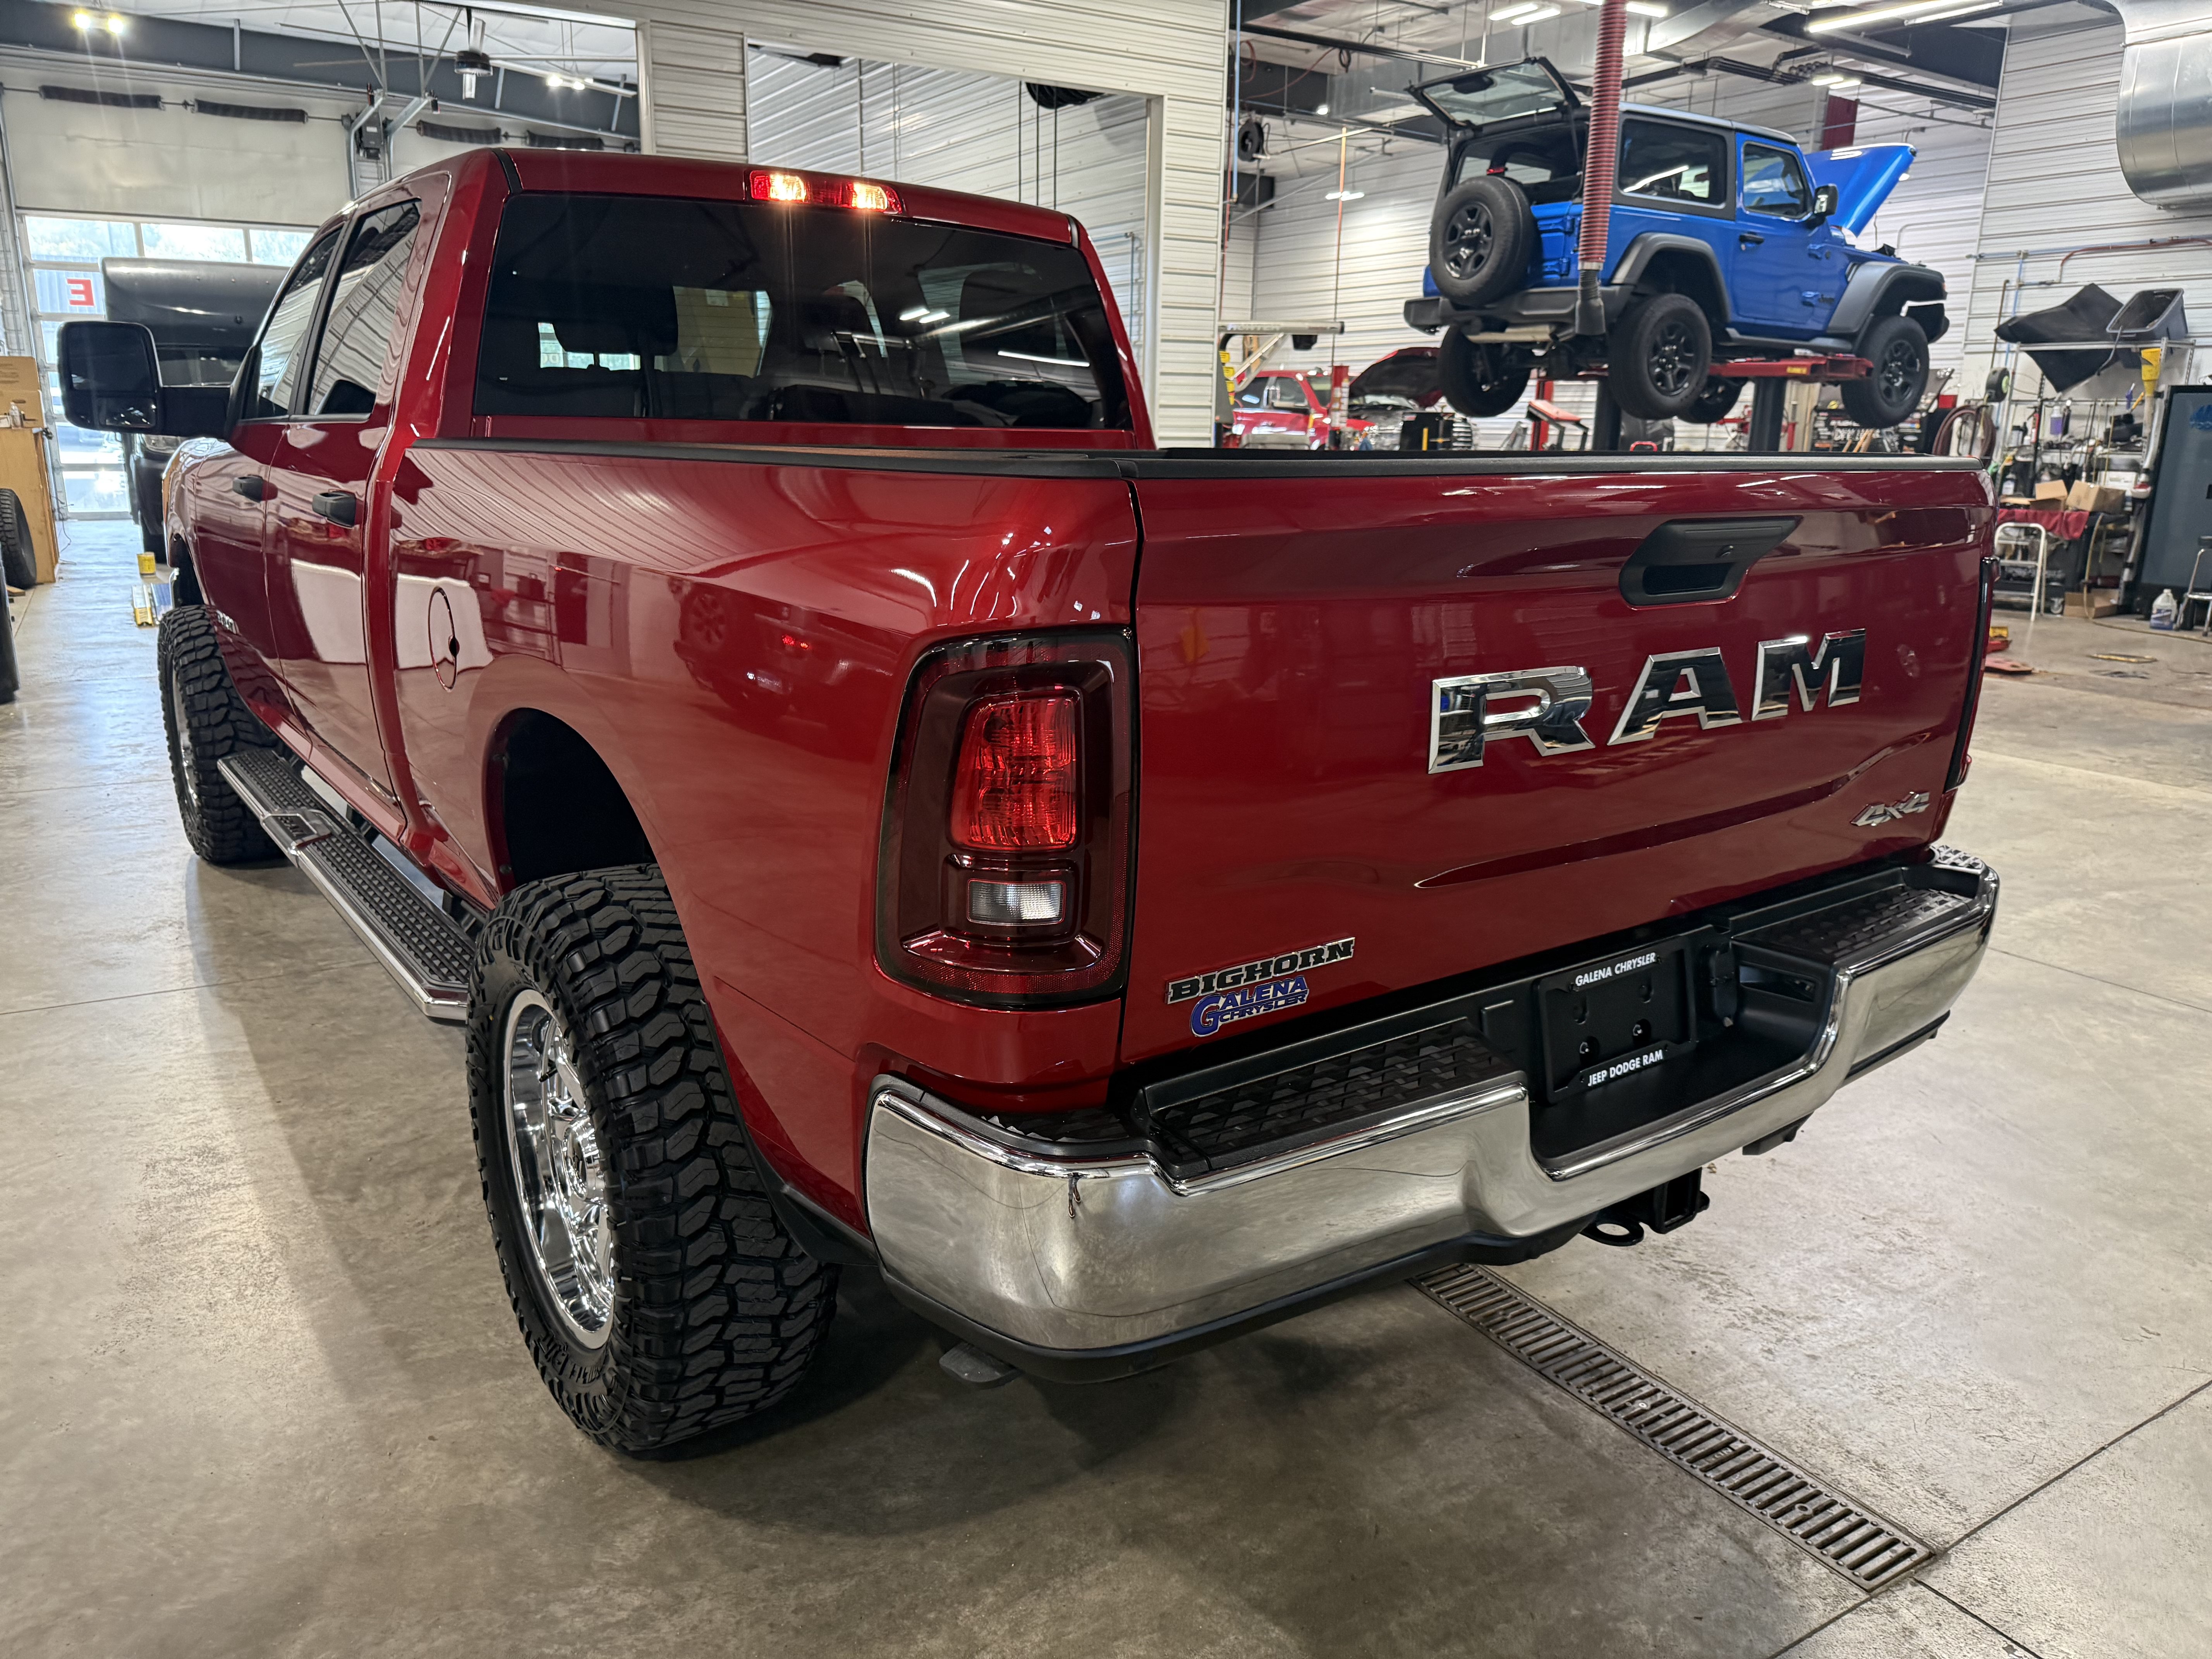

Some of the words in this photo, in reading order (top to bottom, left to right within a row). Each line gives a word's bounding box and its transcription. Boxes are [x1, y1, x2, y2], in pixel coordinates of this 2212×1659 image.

[1428, 628, 1866, 774] RAM
[1166, 937, 1355, 1004] BIGHORN
[1575, 966, 1613, 986] GALENA
[1614, 952, 1656, 974] CHRYSLER
[1190, 975, 1309, 1037] GALENA
[1219, 993, 1305, 1023] CHRYSLER
[1588, 1070, 1607, 1087] JEEP
[1609, 1057, 1641, 1079] DODGE
[1642, 1049, 1663, 1066] RAM
